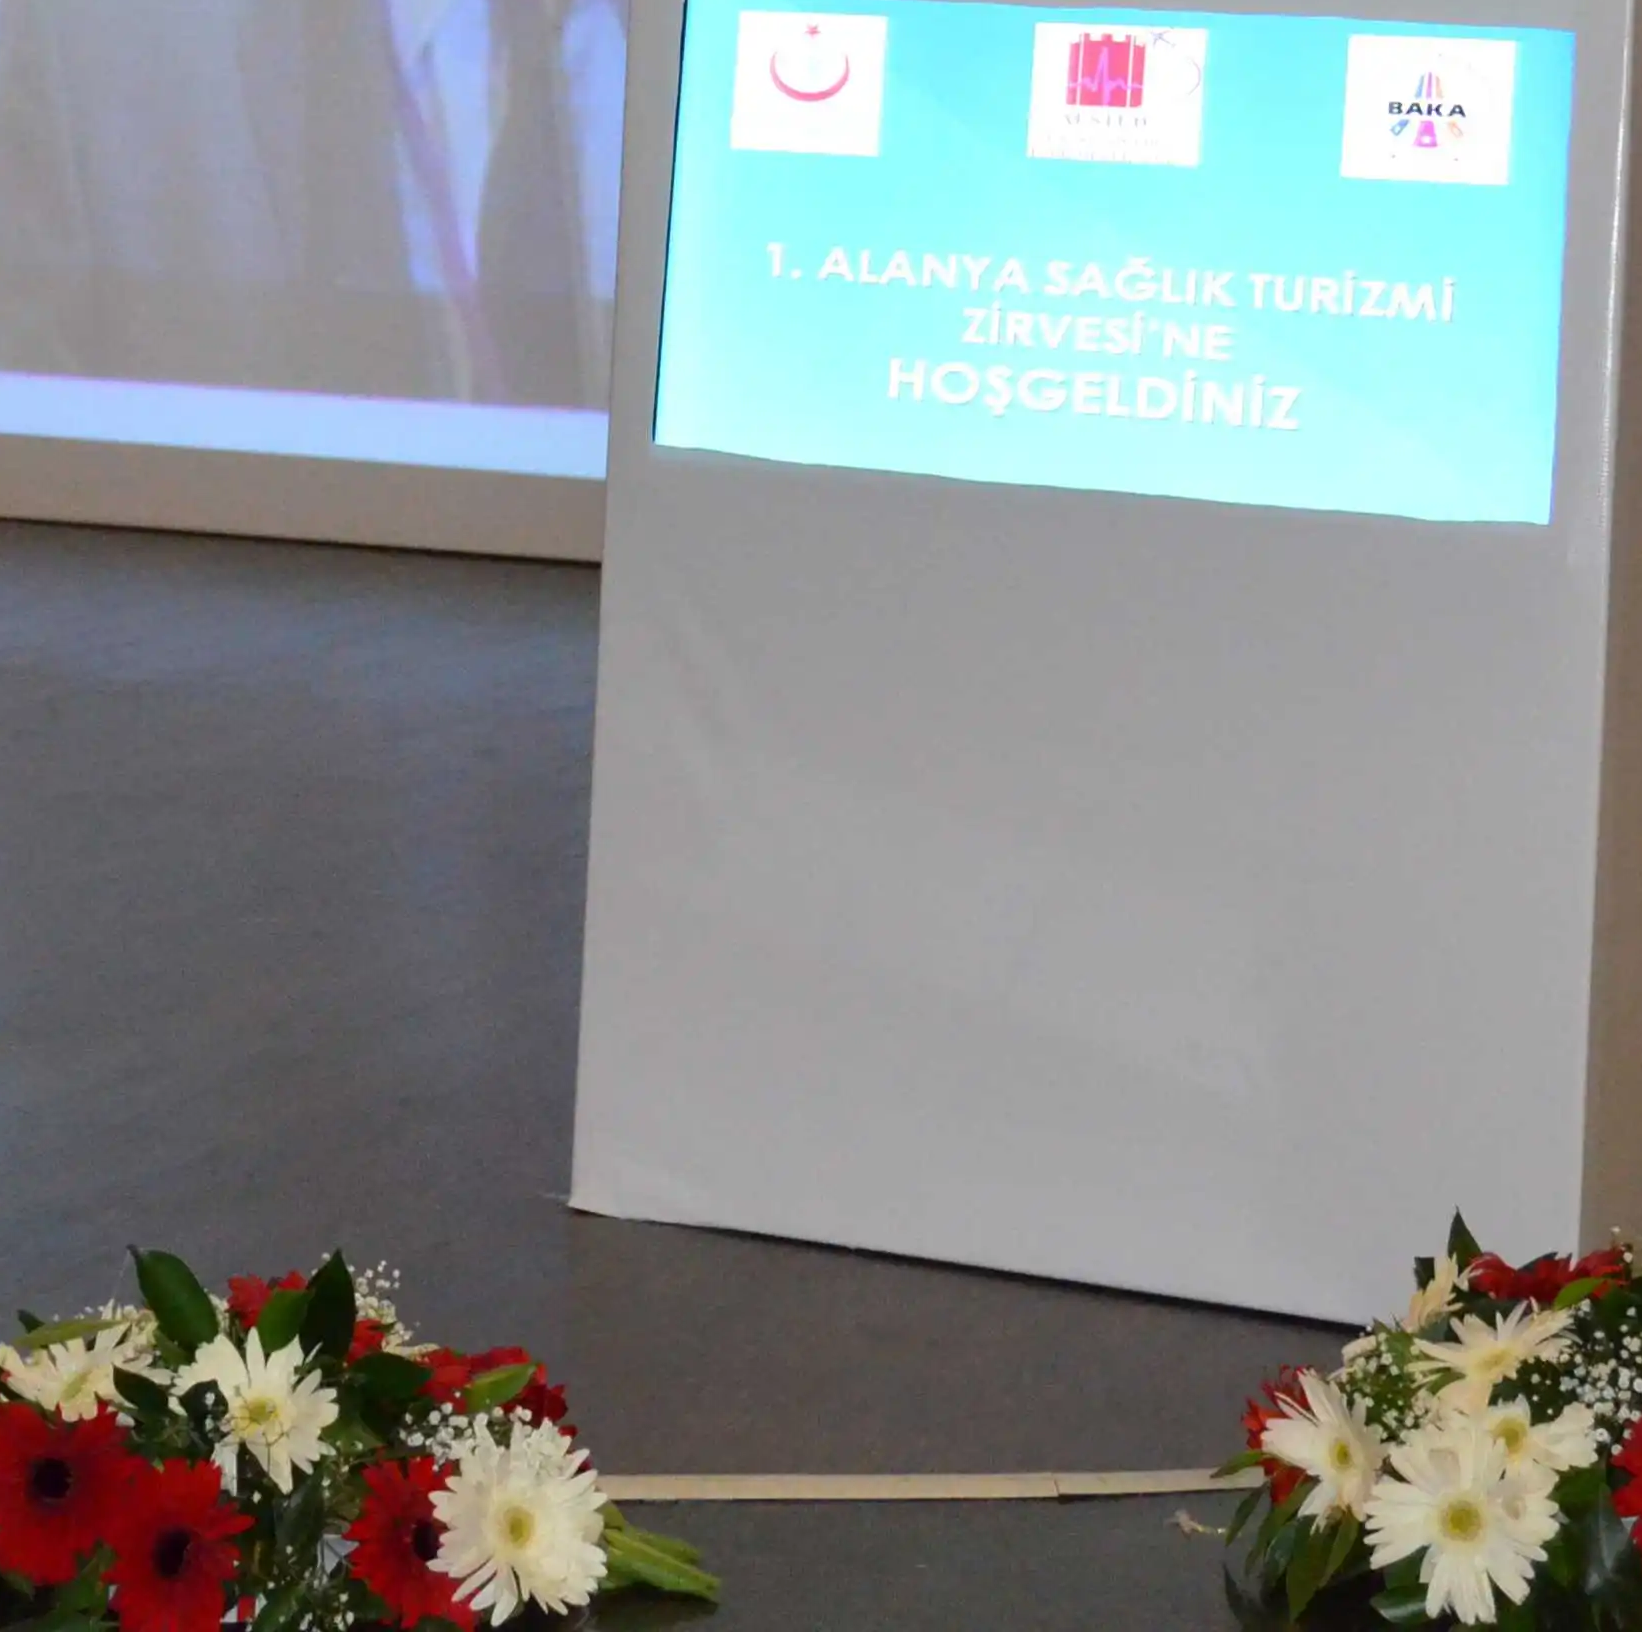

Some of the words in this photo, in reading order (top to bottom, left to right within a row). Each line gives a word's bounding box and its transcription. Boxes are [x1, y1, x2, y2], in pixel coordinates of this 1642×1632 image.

[1387, 100, 1467, 118] BAKA
[766, 240, 803, 282] 1.
[816, 244, 1031, 297] ALANYA
[1040, 252, 1237, 310] SAĞLIK
[1247, 266, 1459, 326] TURİZMİ
[959, 299, 1235, 363] ZİRVESİ'NE
[885, 353, 1304, 433] HOŞGELDİNİZ
